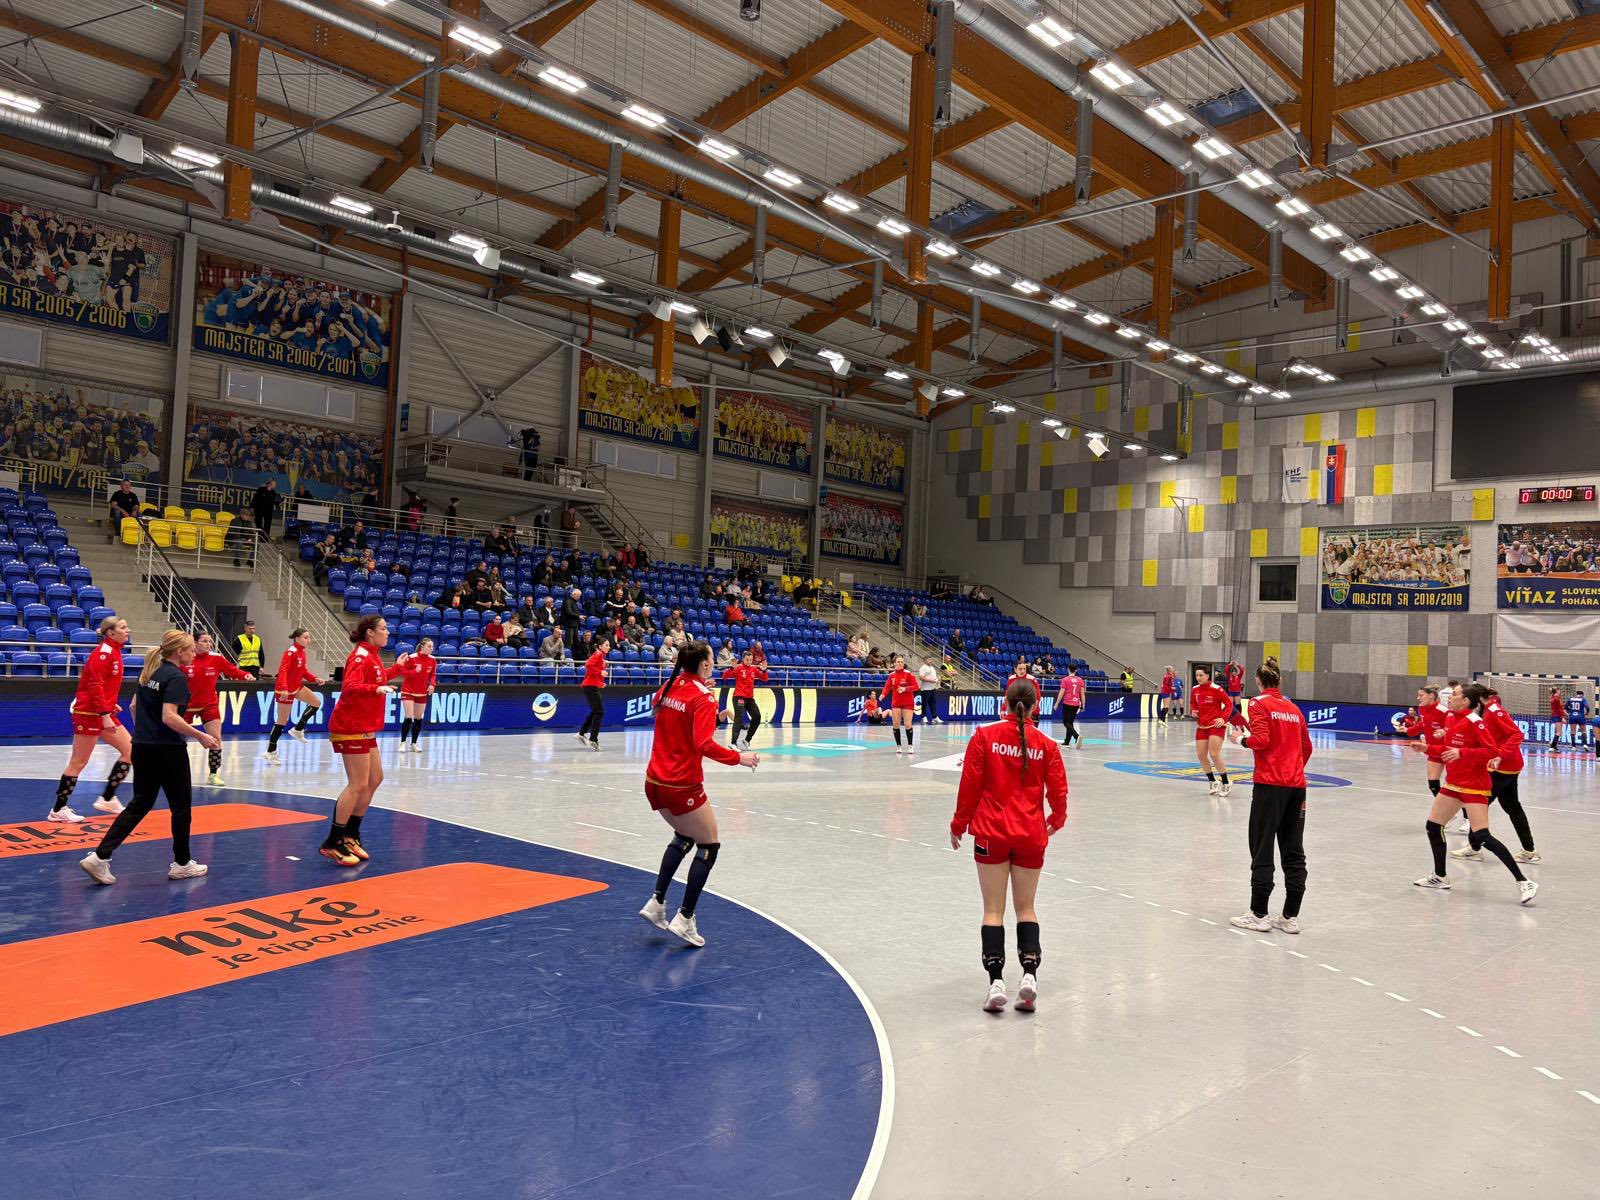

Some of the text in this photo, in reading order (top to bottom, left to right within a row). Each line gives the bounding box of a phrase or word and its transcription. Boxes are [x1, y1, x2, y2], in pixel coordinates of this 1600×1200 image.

[12, 287, 32, 310] SR
[35, 291, 127, 329] 2005/2006
[204, 329, 357, 377] MAJSTER SR 2006/2007
[585, 411, 623, 432] MAJSTER
[719, 439, 749, 457] MAJSTER
[28, 460, 112, 491] 2014/2015
[825, 462, 850, 480] MAJSTER
[1522, 492, 1530, 503] 0
[1541, 489, 1573, 500] 00:00
[1584, 489, 1593, 500] 0
[824, 540, 849, 555] MAJSTER
[1352, 593, 1463, 606] MAJSTER SR 2018/2019
[1505, 586, 1557, 604] VÍŤAZ
[1561, 597, 1599, 606] POHÁRA
[1071, 684, 1077, 696] 7
[430, 692, 486, 723] NOW
[949, 695, 969, 716] BUY
[971, 695, 995, 716] YOUR
[1108, 696, 1125, 713] EHF
[1570, 702, 1581, 711] 10
[1308, 706, 1338, 723] EHF
[211, 913, 425, 971] je tipovanie
